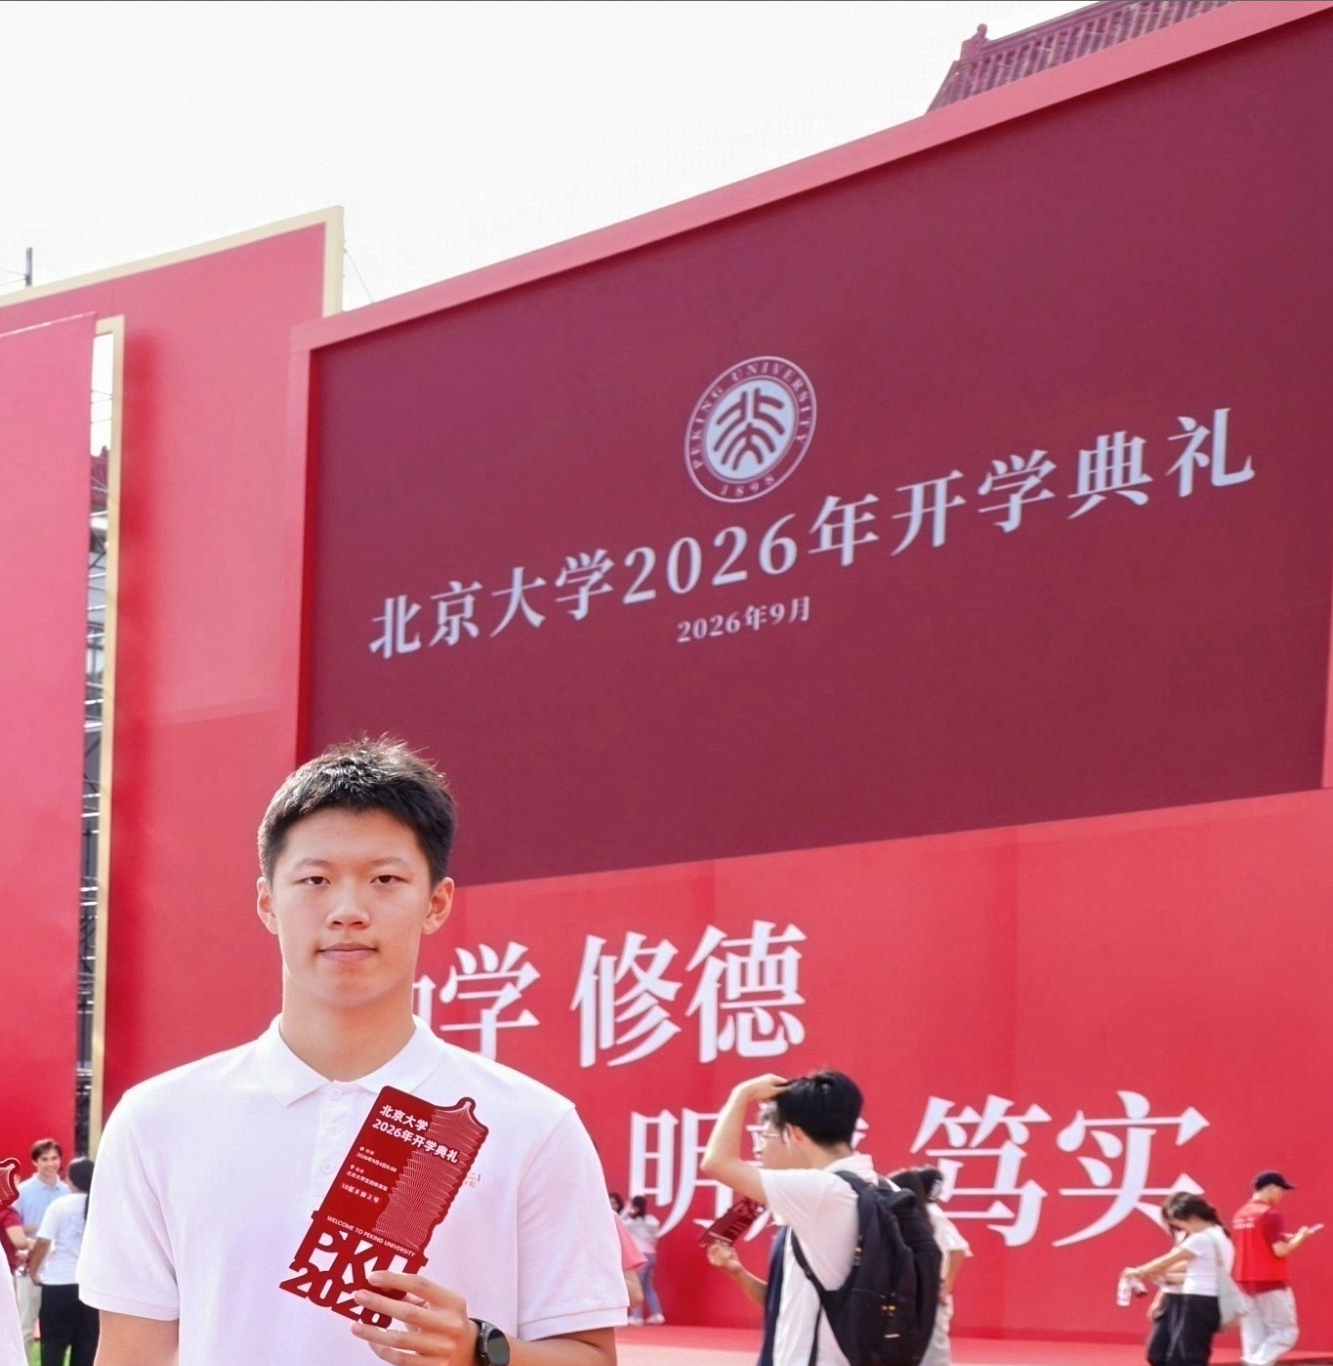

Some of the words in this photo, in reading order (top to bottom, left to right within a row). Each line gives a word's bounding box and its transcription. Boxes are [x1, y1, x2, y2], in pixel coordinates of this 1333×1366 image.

[690, 386, 723, 470] PEKING
[731, 362, 812, 444] UNIVERSITY
[720, 473, 775, 497] 1898
[368, 406, 1256, 661] 北京大学2026年开学典礼
[676, 595, 811, 644] 2026年9月
[413, 941, 542, 1063] 学
[570, 919, 808, 1069] 修德
[371, 1118, 463, 1163] 2026年开学典礼
[378, 1104, 428, 1131] 北京大学
[911, 1089, 1212, 1248] 笃实
[326, 1214, 355, 1231] WELCOME
[362, 1230, 384, 1243] PEKING
[383, 1239, 415, 1257] UNIVERSITY
